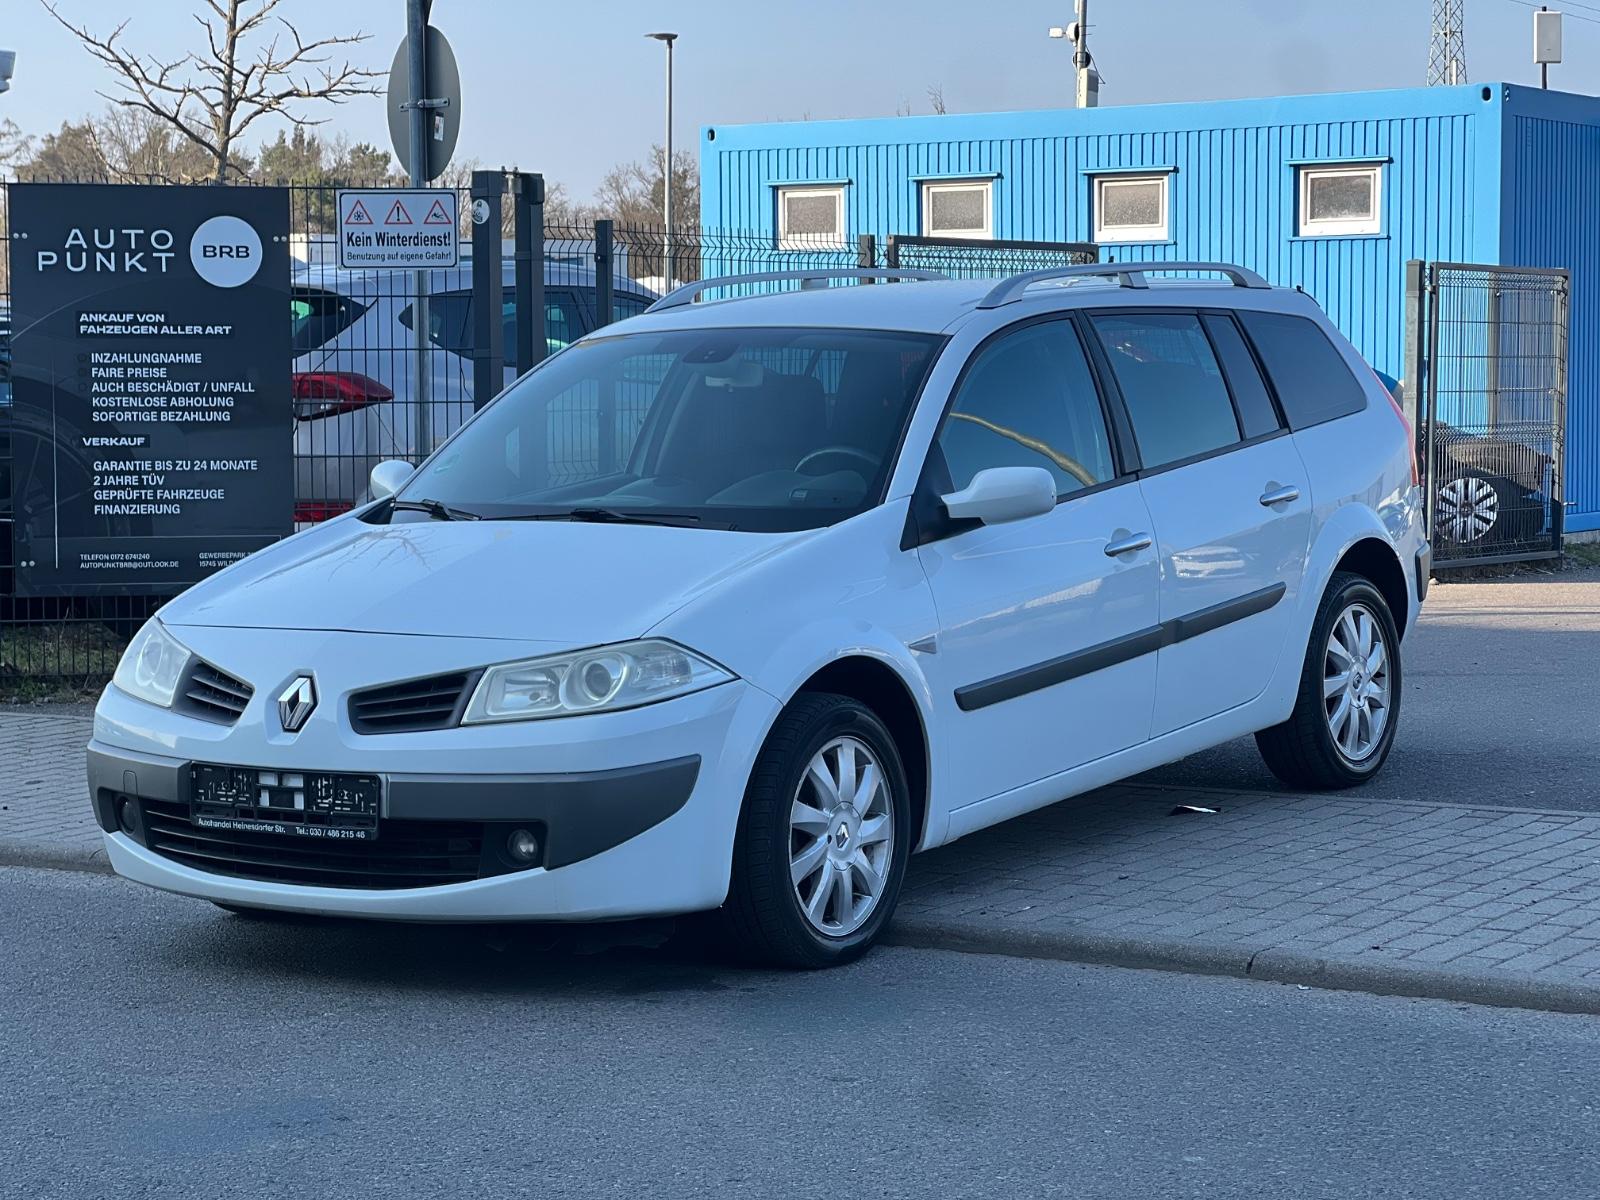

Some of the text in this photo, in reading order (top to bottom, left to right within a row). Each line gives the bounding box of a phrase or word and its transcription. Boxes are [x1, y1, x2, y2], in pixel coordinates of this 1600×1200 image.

[64, 228, 174, 250] AUTO
[346, 231, 451, 247] Kein Winterdienst!
[202, 245, 250, 259] BRB
[347, 251, 451, 262] Benutzung auf eigene Gefahr!
[37, 251, 175, 273] PUNKT
[79, 313, 165, 323] ANKAUF VON
[80, 325, 232, 335] FAHZEUGEN ALLER ART
[91, 352, 202, 364] INZAHLUNGNAHME
[91, 367, 167, 378] FAIRE PREISE
[91, 379, 255, 393] AUCH BESCHÄDIGT / UNFALL
[92, 396, 234, 407] KOSTENLOSE ABHOLUNG
[92, 411, 231, 422] SOFORTIGE BEZAHLUNG
[82, 437, 146, 447] VERKAUF
[93, 459, 258, 471] GARANTIE BIS ZU 24 MONATE
[93, 473, 165, 486] 2 JAHRE TÜV
[93, 487, 225, 501] GEPRÜFTE FAHRZEUGE
[94, 504, 181, 515] FINANZIERUNG
[80, 553, 109, 561] TELEFON
[274, 824, 286, 833] Str.
[309, 828, 321, 836] 030
[340, 830, 354, 838] 215
